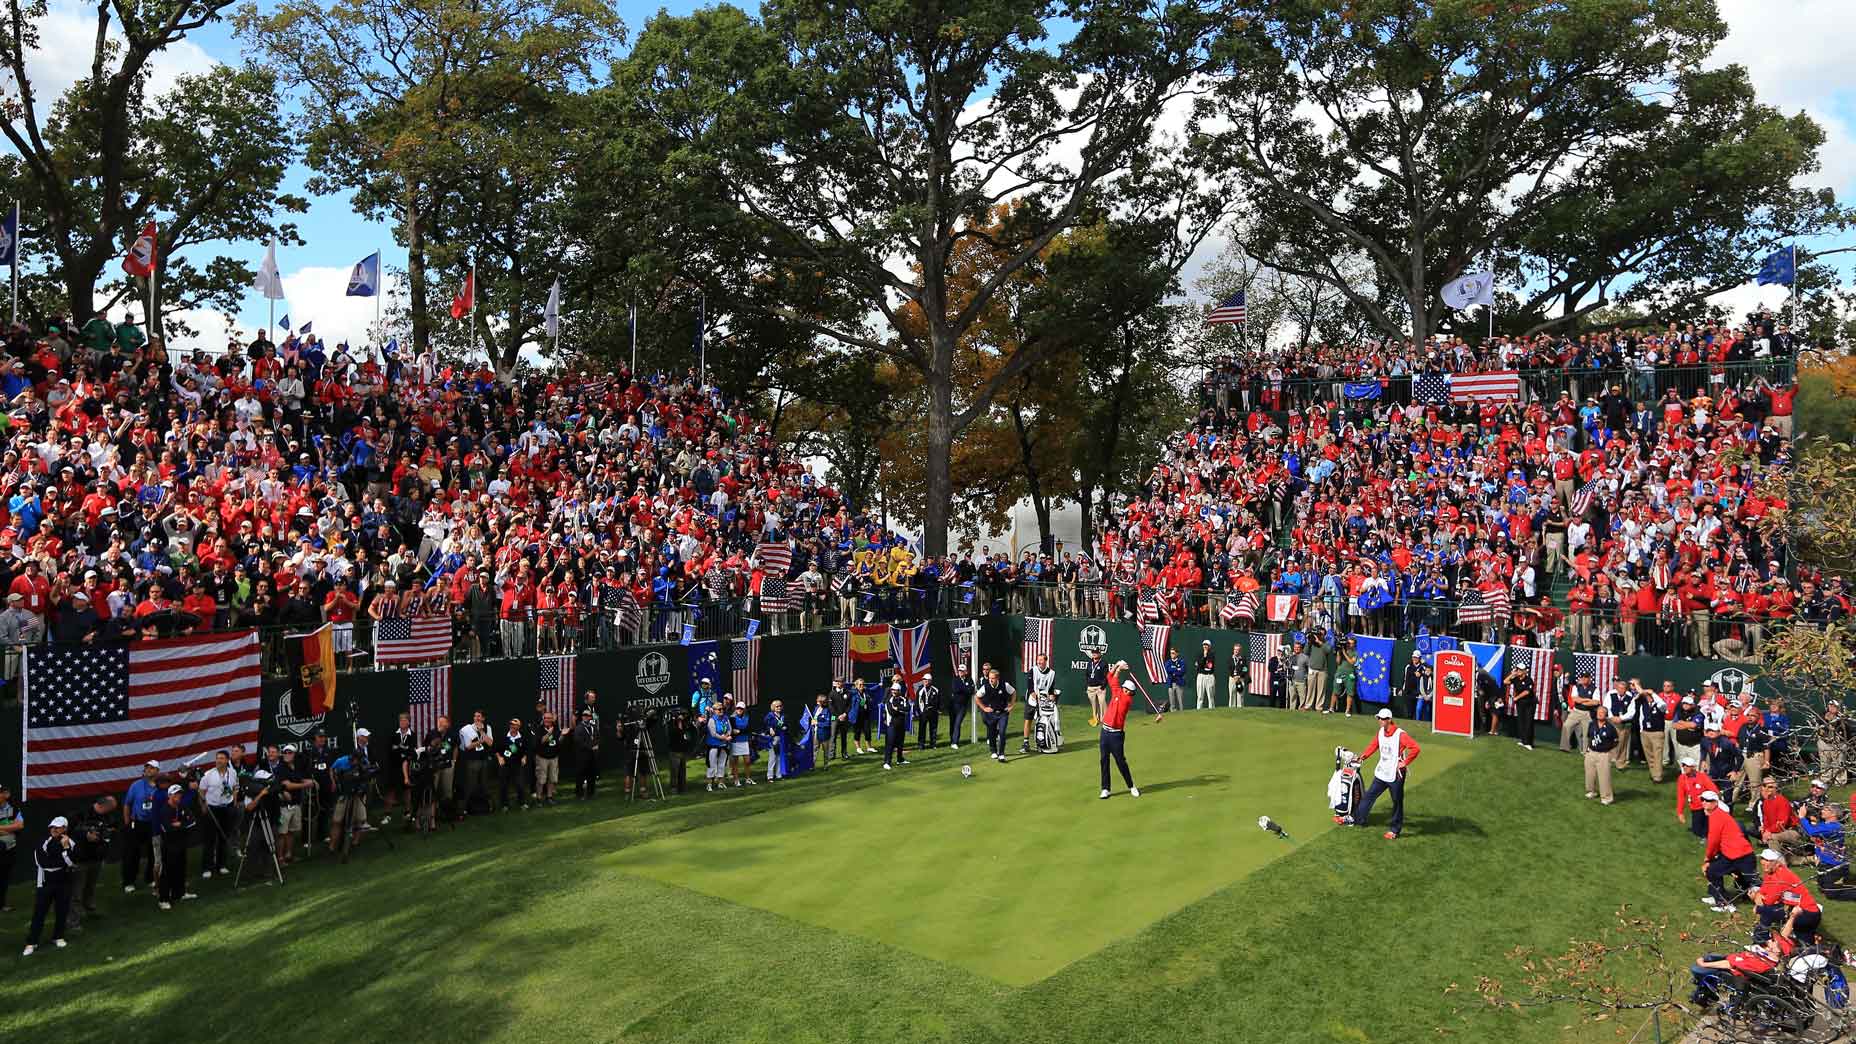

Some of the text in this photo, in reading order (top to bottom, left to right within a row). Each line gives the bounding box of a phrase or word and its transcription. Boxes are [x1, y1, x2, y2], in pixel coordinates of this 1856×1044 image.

[638, 674, 668, 684] RYDER CUP
[627, 695, 678, 709] MEDINAH
